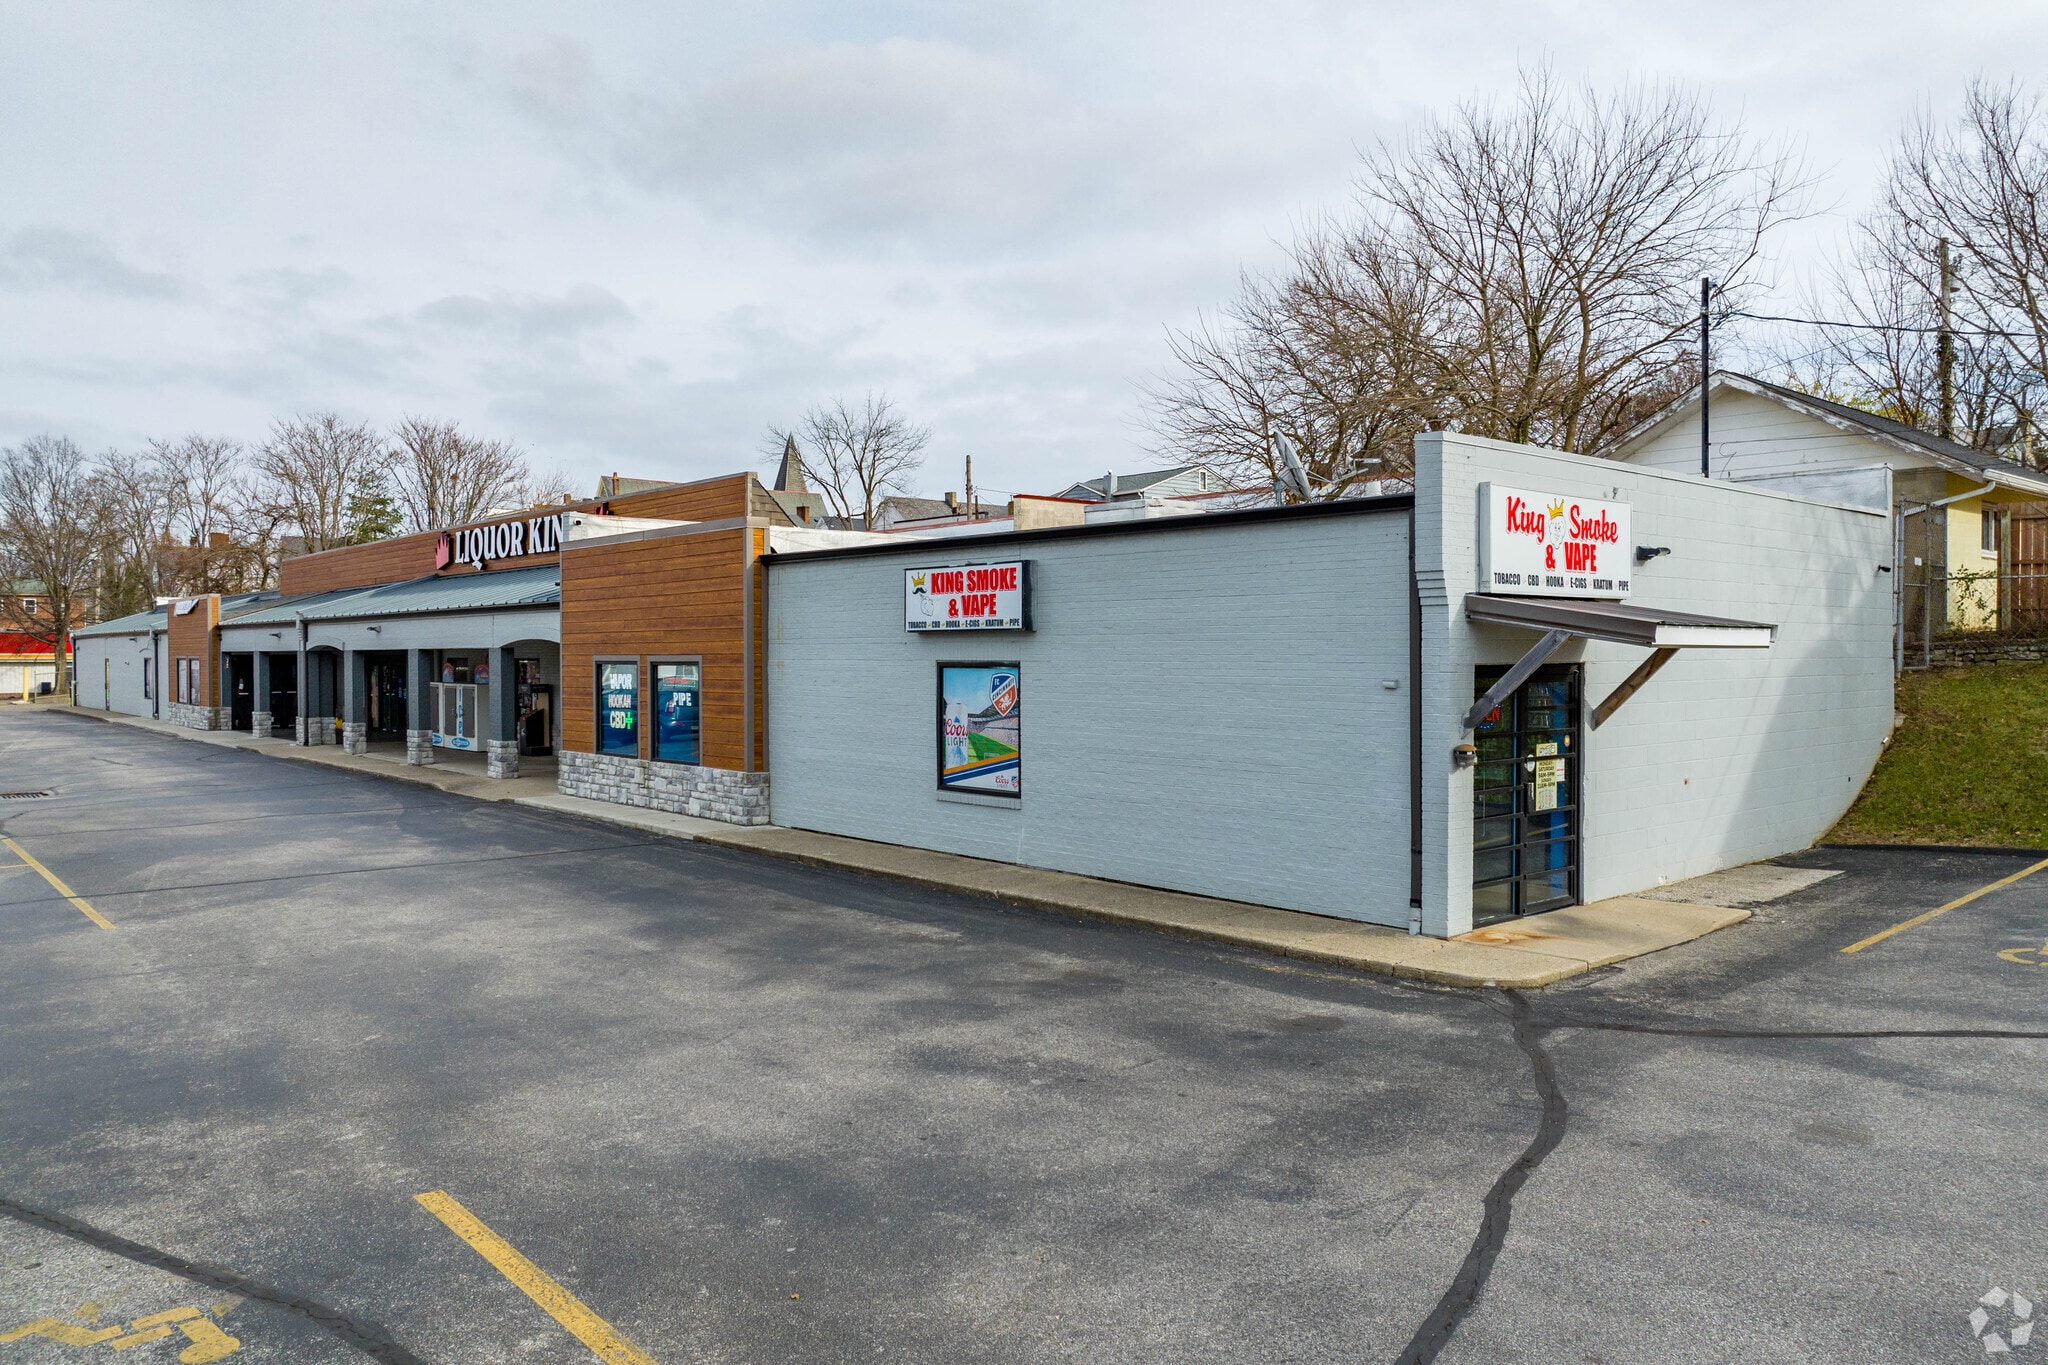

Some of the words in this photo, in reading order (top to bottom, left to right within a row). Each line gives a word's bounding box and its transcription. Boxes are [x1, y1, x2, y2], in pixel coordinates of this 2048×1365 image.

[1506, 495, 1545, 545] King
[1569, 504, 1619, 544] Smoke
[455, 521, 524, 570] LIQUOR
[1545, 544, 1556, 571] &
[1564, 541, 1597, 573] VAPE
[931, 570, 963, 595] KING
[966, 567, 1017, 592] SMOKE
[1494, 572, 1521, 586] TOBACCO
[1527, 574, 1540, 587] CBD
[1546, 576, 1564, 588] HOOKA
[1570, 577, 1587, 589] E-CIGS
[1618, 580, 1629, 592] PIPE
[948, 598, 959, 618] &
[961, 593, 997, 617] VAPE
[908, 621, 927, 629] TOBACCO
[1009, 618, 1020, 626] PIPE
[610, 673, 632, 690] VAPOR
[608, 694, 631, 708] HOOKAH
[673, 692, 692, 707] PIPE
[610, 710, 626, 729] CBD
[947, 737, 967, 747] LIGHT
